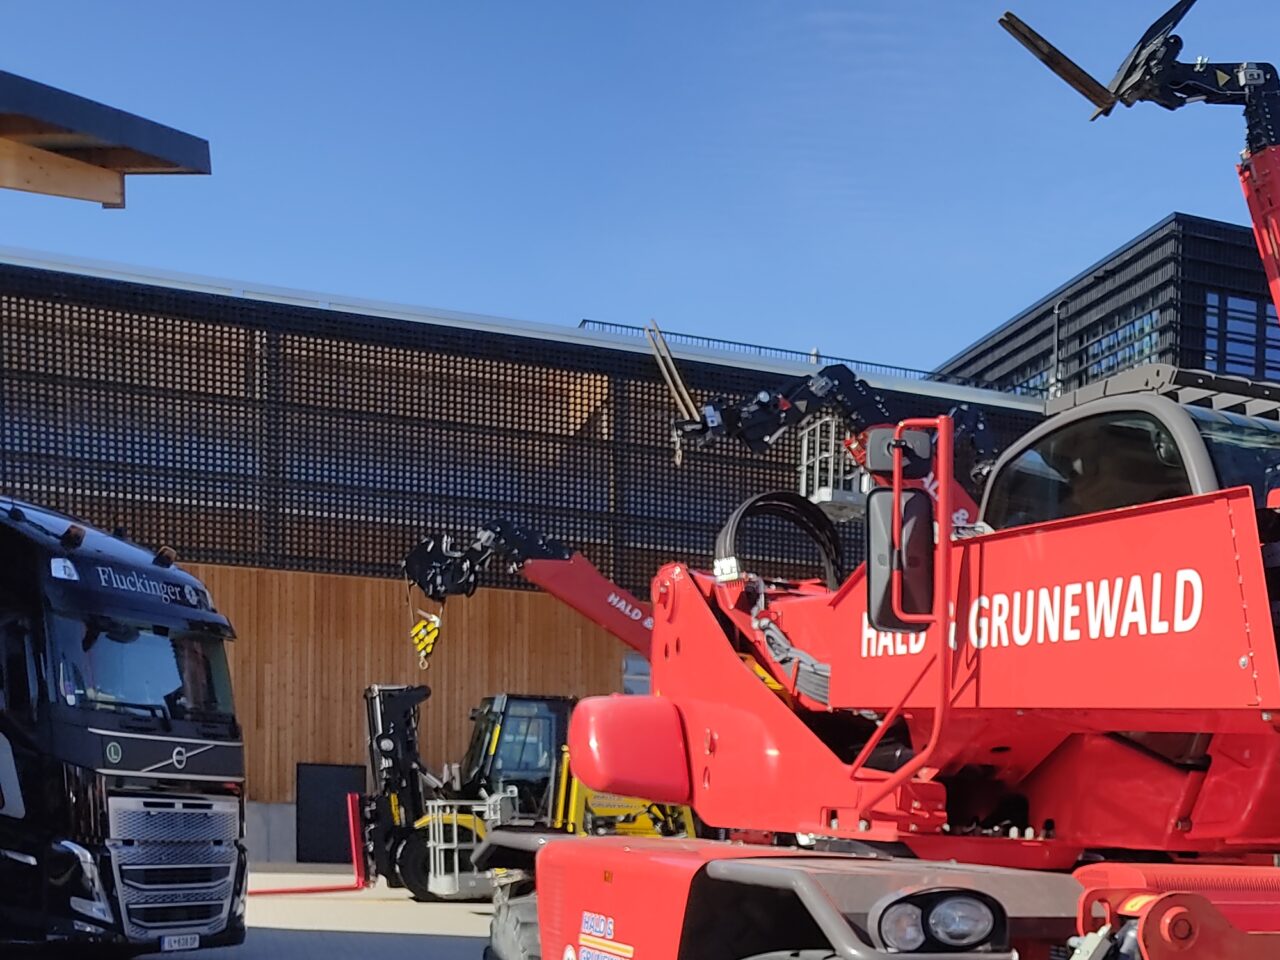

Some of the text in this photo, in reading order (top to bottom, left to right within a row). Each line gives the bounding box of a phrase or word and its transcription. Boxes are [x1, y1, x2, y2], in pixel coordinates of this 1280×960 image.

[96, 566, 181, 604] Fluckinger
[608, 592, 642, 620] HALD
[969, 568, 1203, 650] GRUNEWALD
